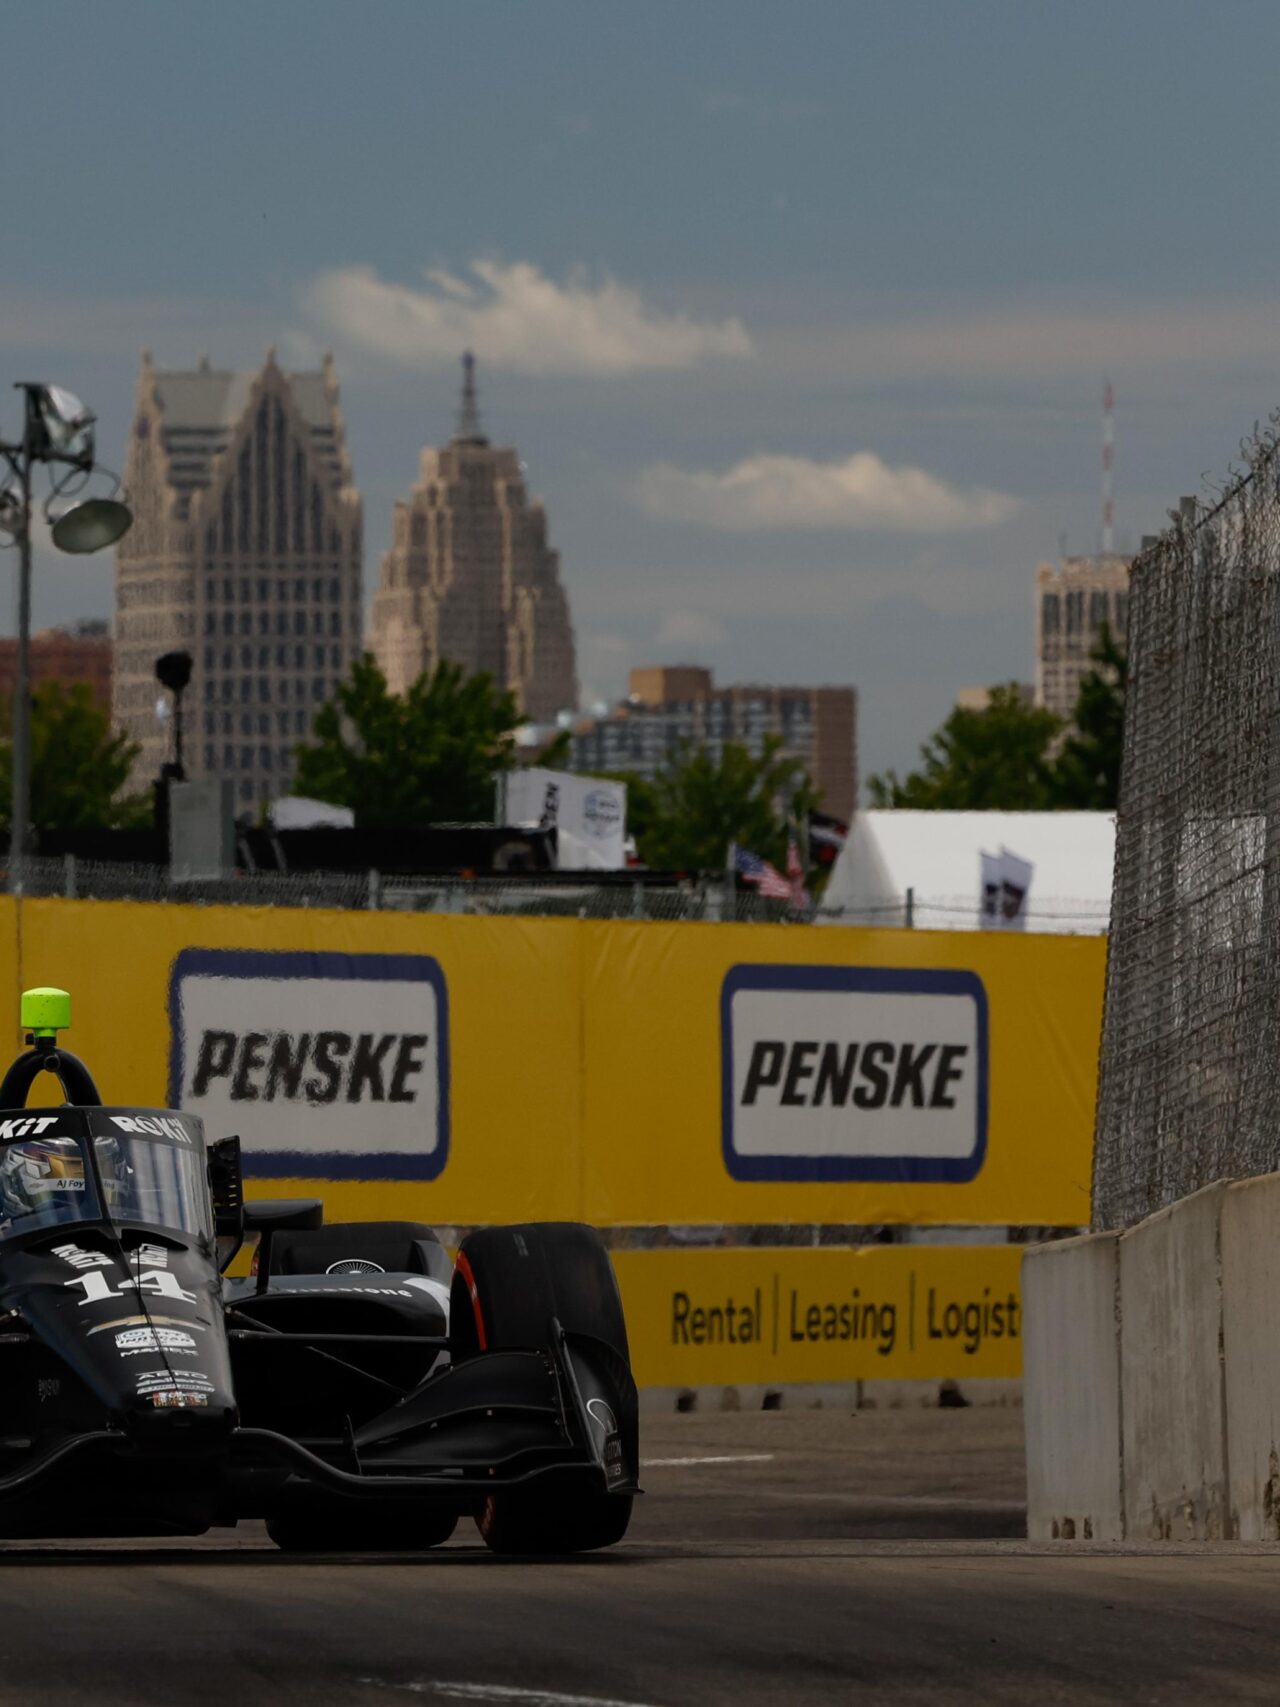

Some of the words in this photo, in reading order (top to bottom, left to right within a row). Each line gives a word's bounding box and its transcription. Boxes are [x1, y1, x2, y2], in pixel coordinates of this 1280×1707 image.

[193, 1030, 428, 1104] PENSKE
[741, 1040, 969, 1108] PENSKE
[63, 1270, 197, 1306] 14
[672, 1288, 761, 1345] Rental
[790, 1288, 898, 1357] Leasing
